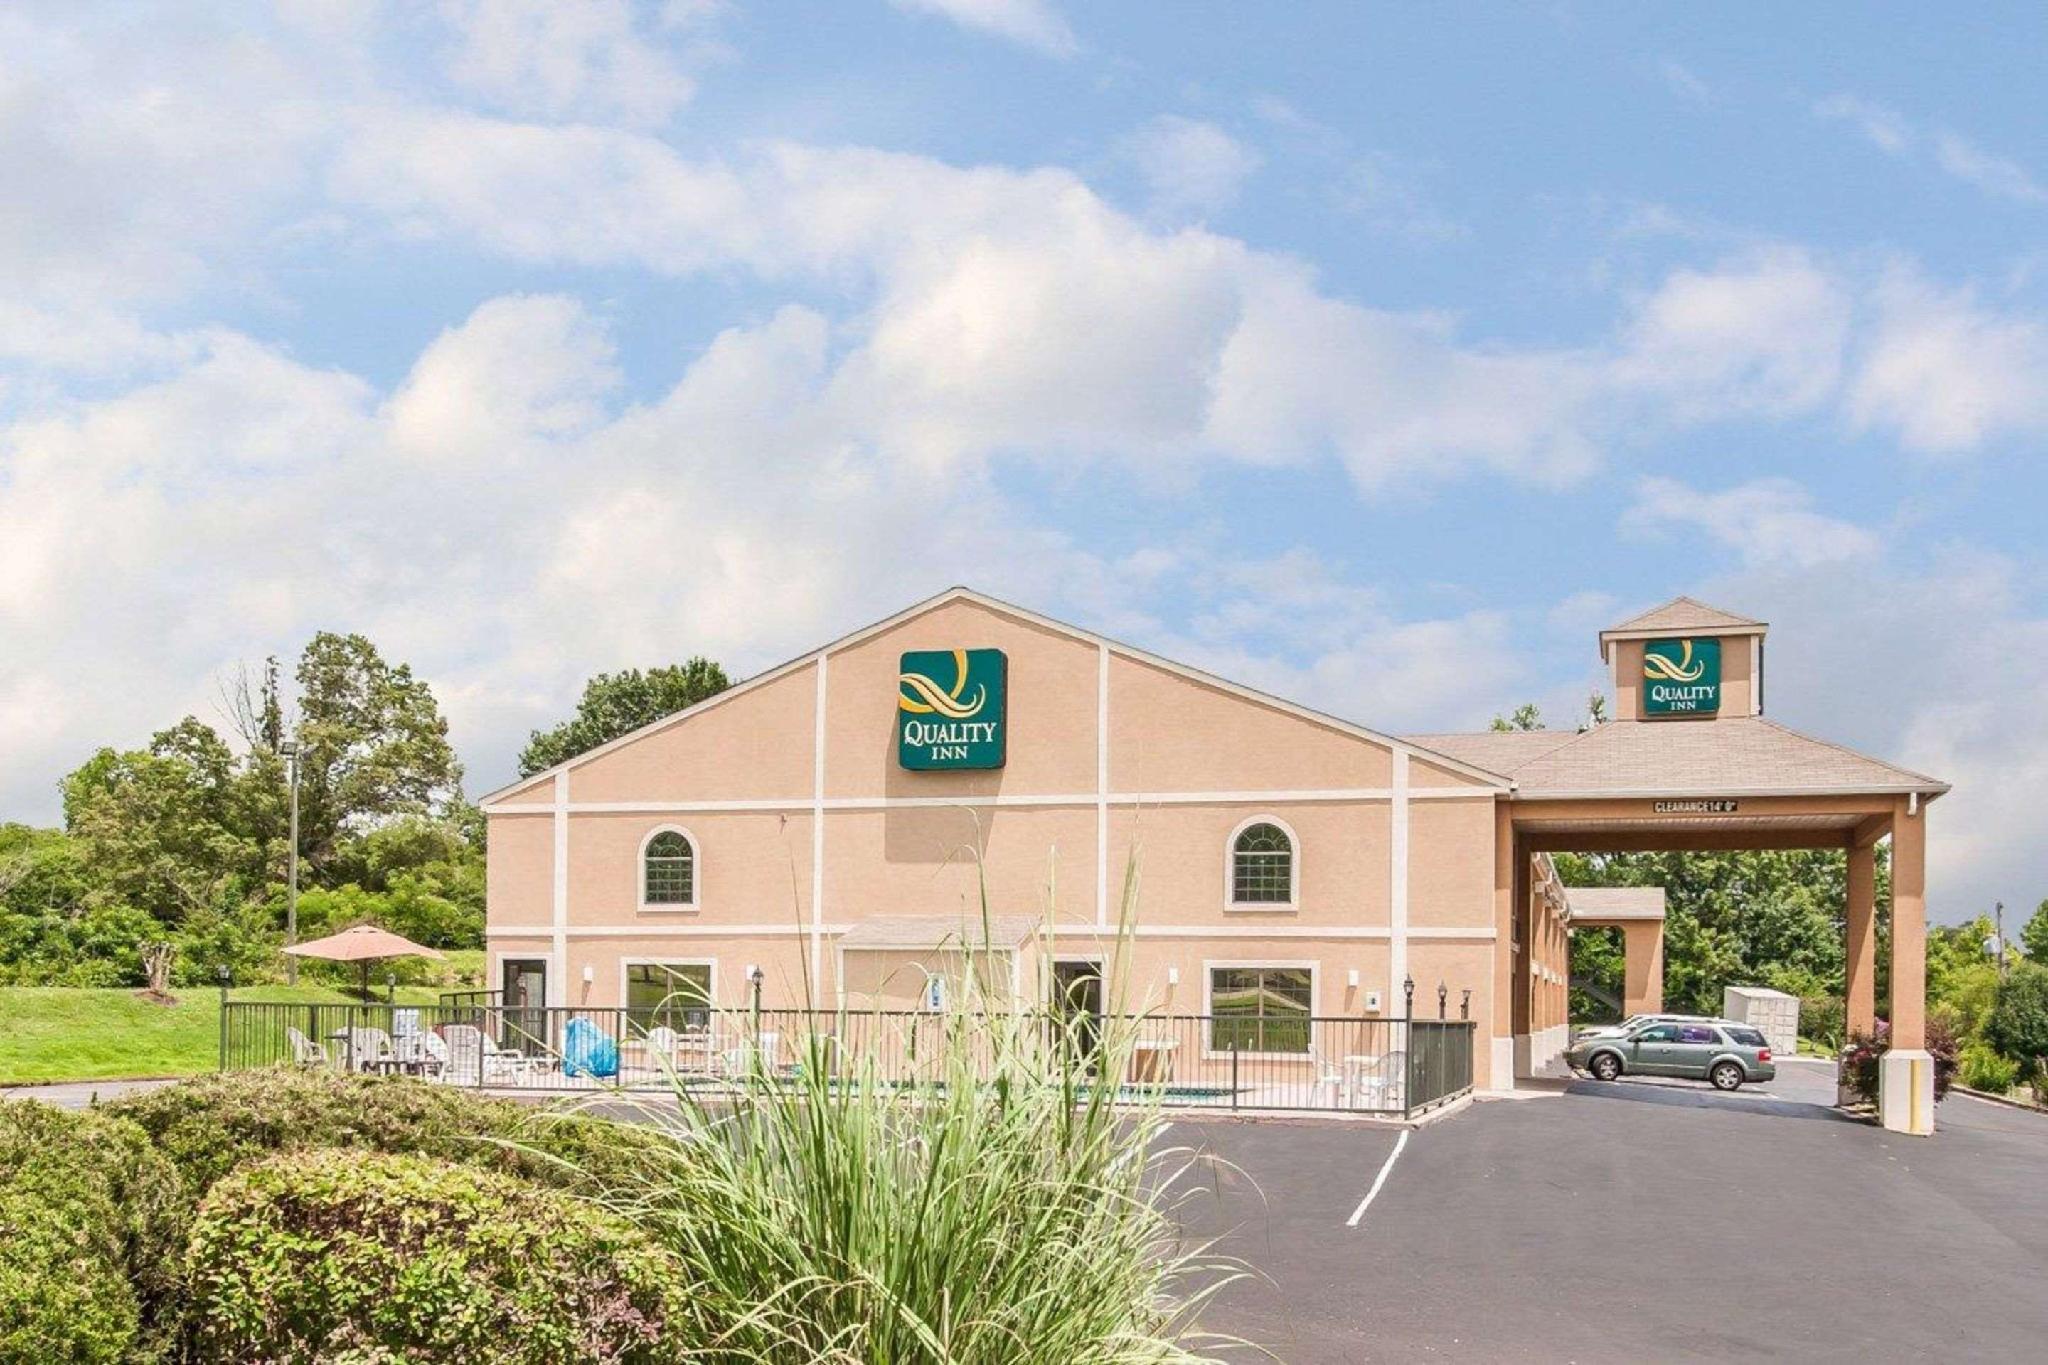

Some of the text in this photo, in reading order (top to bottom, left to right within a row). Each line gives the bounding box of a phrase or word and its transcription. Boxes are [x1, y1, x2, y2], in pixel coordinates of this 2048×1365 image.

[1652, 685, 1715, 702] QUALITY
[1670, 701, 1696, 711] INN
[904, 720, 998, 747] QUALITY
[932, 746, 969, 760] INN
[1655, 801, 1709, 812] CLEARANCE
